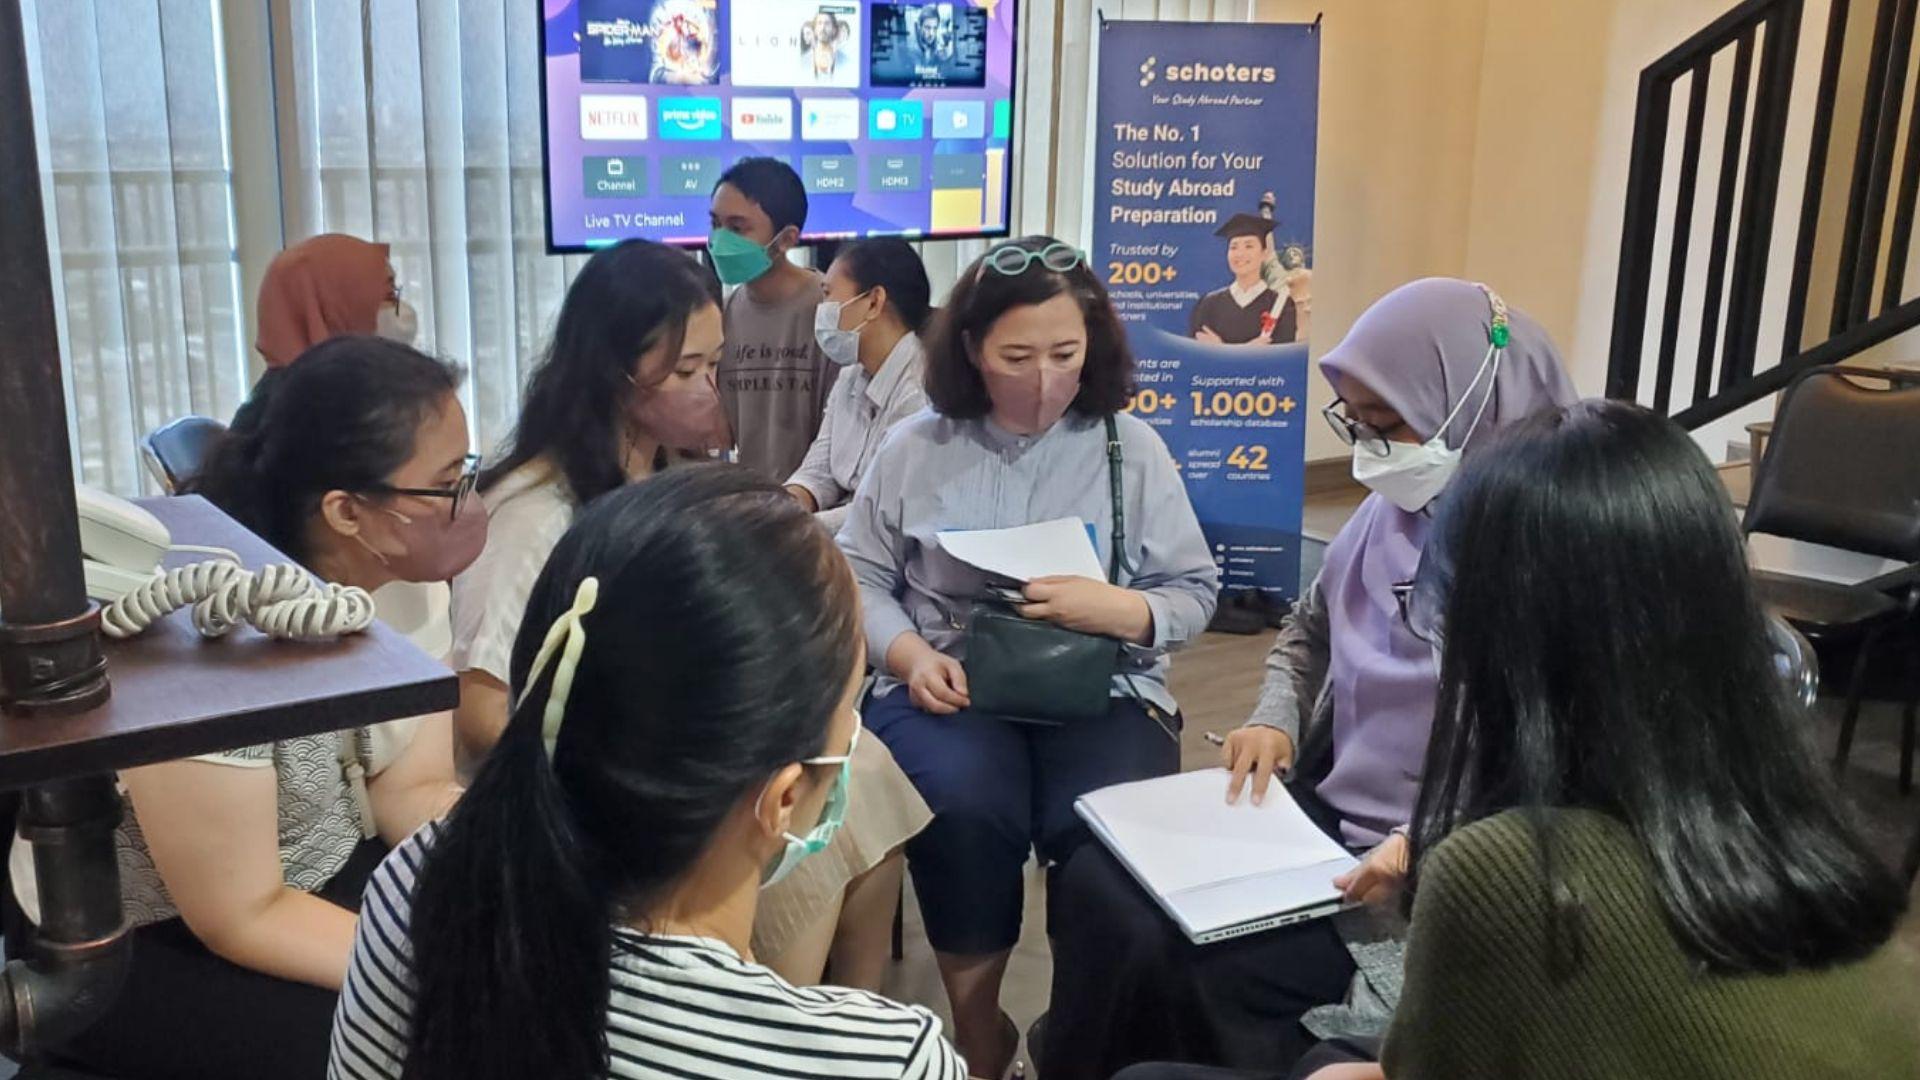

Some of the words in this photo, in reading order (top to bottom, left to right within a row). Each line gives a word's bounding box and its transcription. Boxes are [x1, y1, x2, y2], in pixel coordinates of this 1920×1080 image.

[1166, 63, 1276, 82] schoters
[1152, 94, 1169, 105] Your
[1197, 94, 1229, 105] Abroad
[1230, 95, 1263, 106] Partner
[587, 111, 640, 126] NETFLIX
[663, 110, 689, 122] prime
[691, 110, 717, 121] video
[902, 113, 915, 126] TV
[1113, 124, 1148, 141] The
[1153, 125, 1184, 142] No.
[1191, 125, 1200, 141] 1
[1112, 152, 1187, 169] Solution
[1192, 152, 1216, 169] for
[1221, 153, 1263, 170] Your
[597, 180, 636, 191] Channel
[684, 179, 698, 190] AV
[816, 178, 845, 188] HDMI2
[882, 176, 909, 187] HDMI3
[1111, 178, 1164, 200] Study
[1168, 179, 1235, 197] Abroad
[584, 214, 610, 228] Live
[614, 213, 631, 228] TV
[635, 212, 685, 227] Channel
[1110, 206, 1217, 227] Preparation
[1110, 243, 1159, 256] Trusted
[1162, 244, 1178, 260] by
[1108, 262, 1177, 284] 200+
[1159, 359, 1181, 369] are
[1161, 372, 1174, 382] in
[1191, 375, 1256, 388] Supported
[1258, 376, 1285, 387] with
[1191, 391, 1296, 416] 1.000+
[1191, 418, 1242, 427] scholarship
[1245, 419, 1288, 427] database
[1188, 449, 1220, 457] alumni
[1227, 445, 1268, 470] 42
[1188, 460, 1221, 470] spread
[1227, 472, 1270, 481] countries
